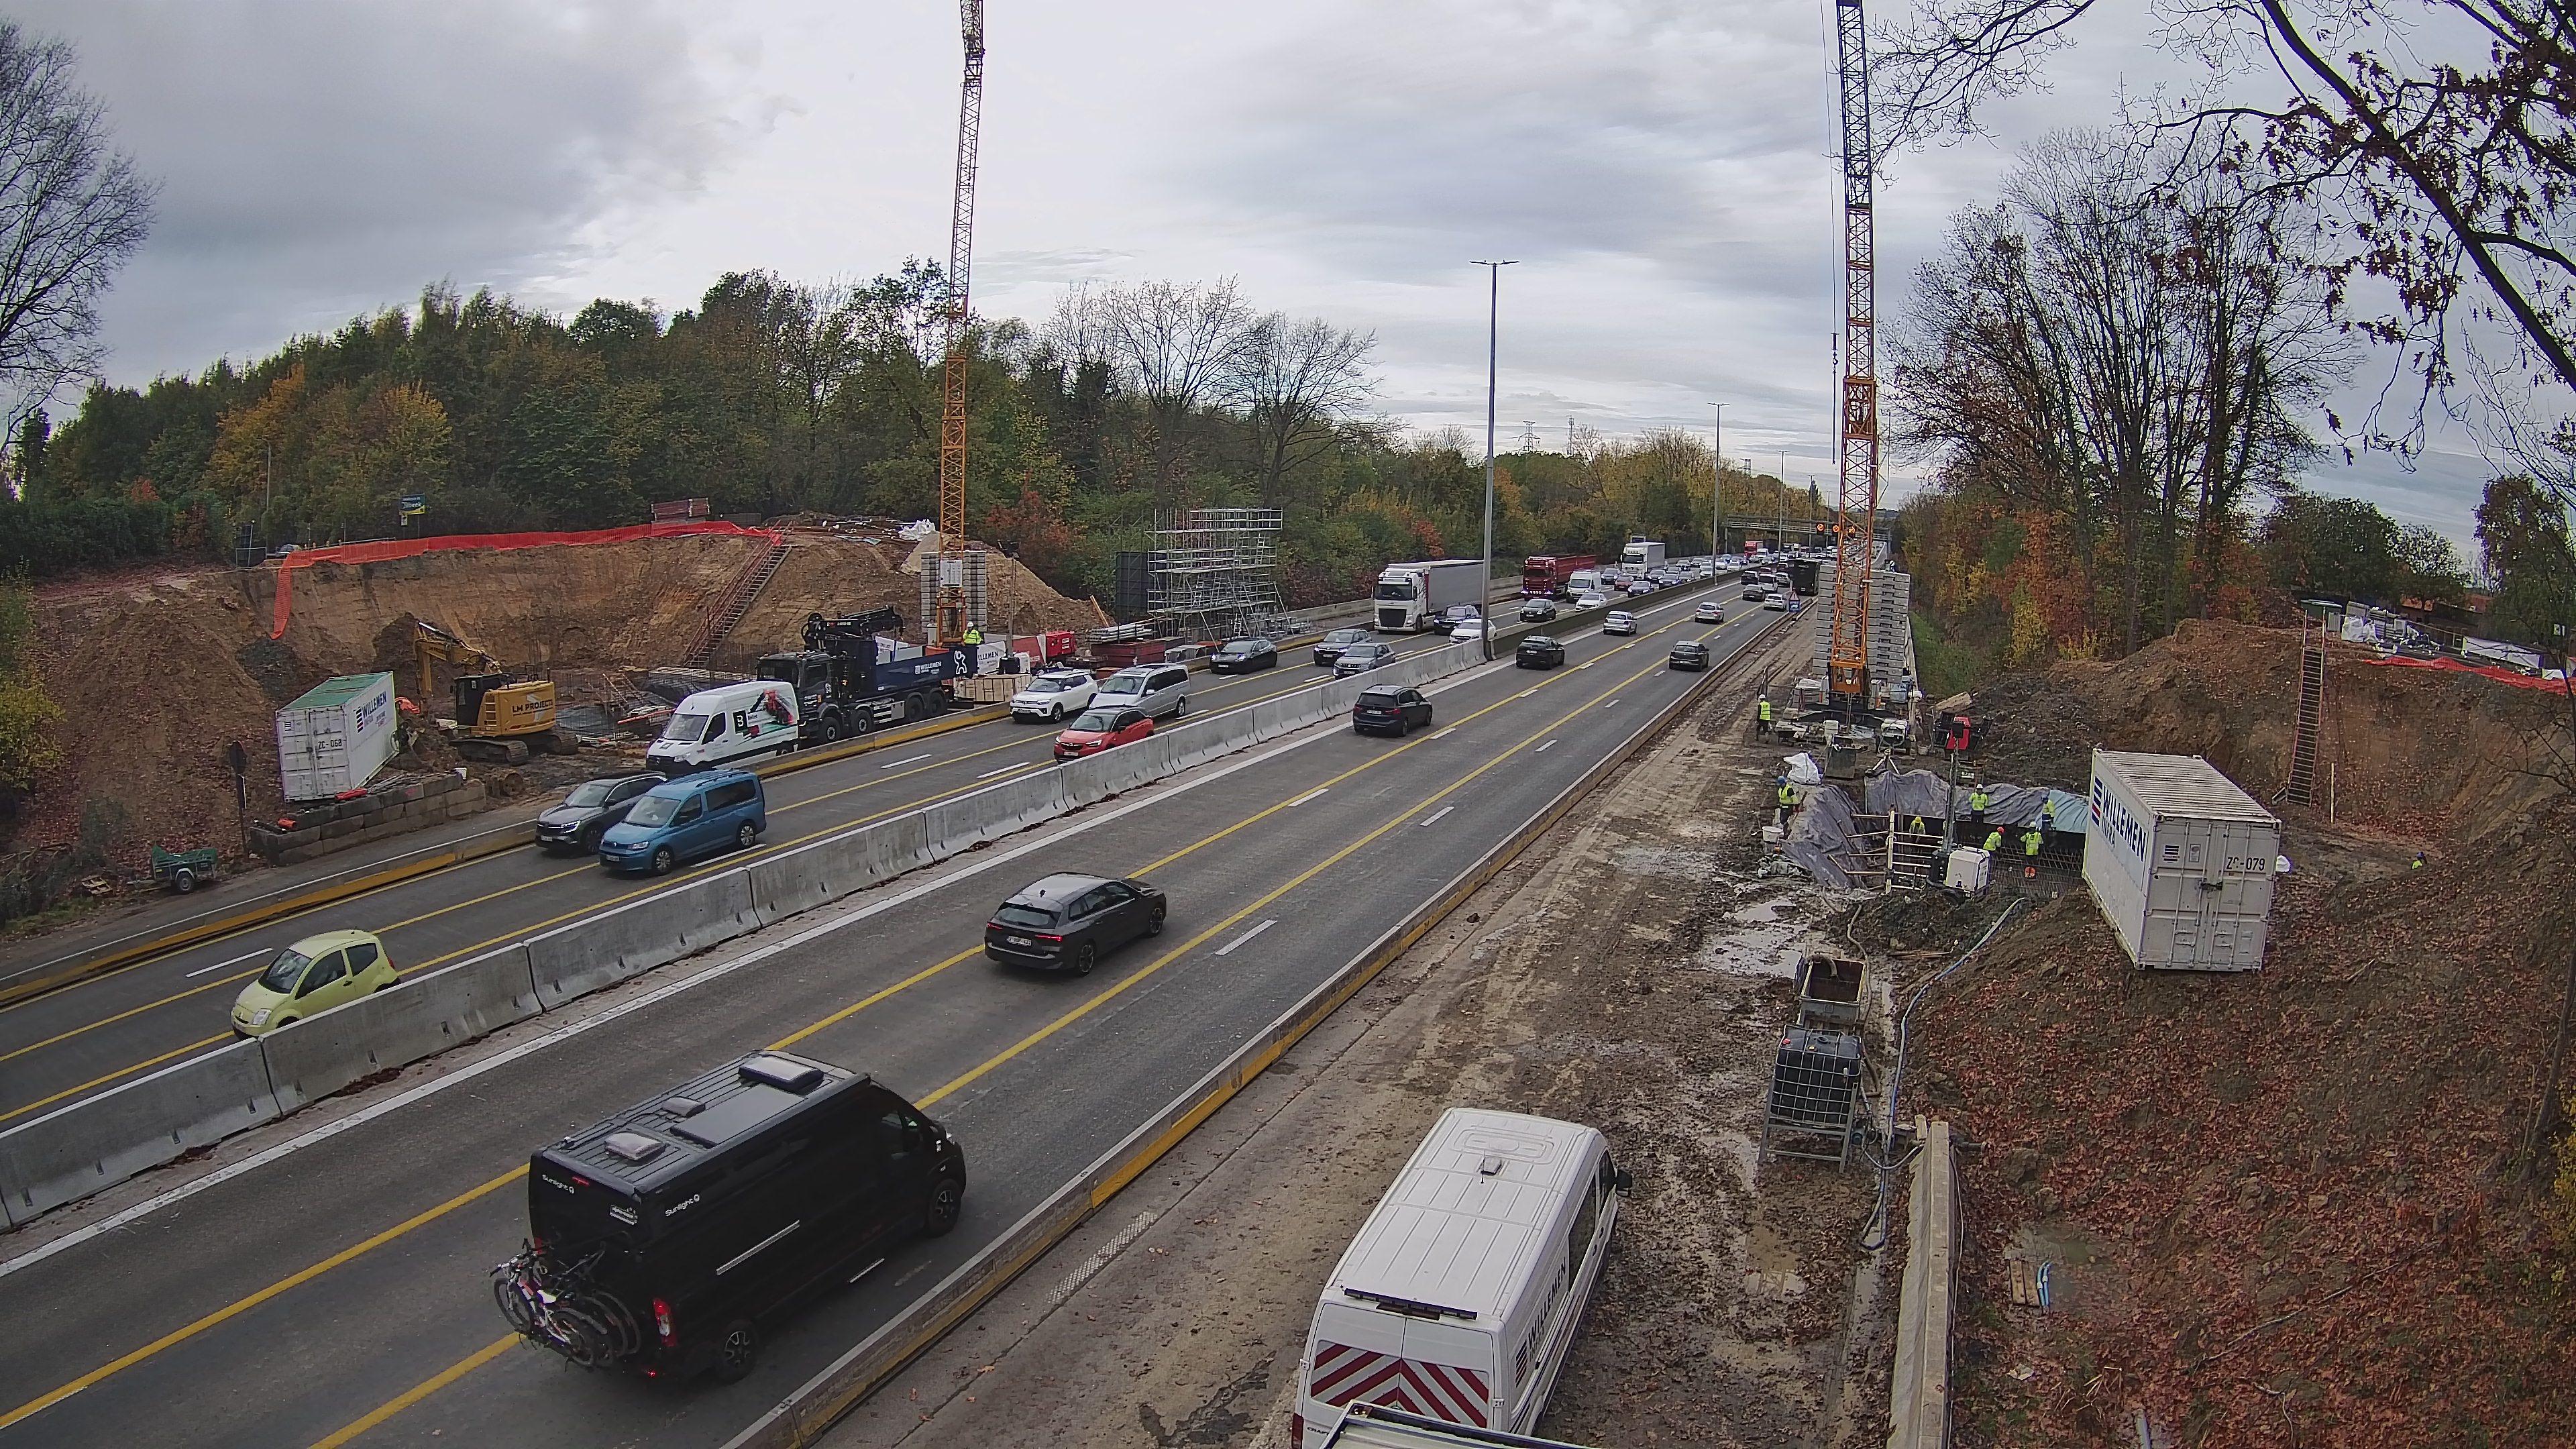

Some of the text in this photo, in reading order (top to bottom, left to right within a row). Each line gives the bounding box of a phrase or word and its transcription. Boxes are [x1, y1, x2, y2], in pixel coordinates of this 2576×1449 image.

[977, 651, 998, 660] ILLEMEN
[362, 690, 387, 718] WILLEMEN
[512, 699, 553, 712] LM PROJECTS
[2101, 816, 2116, 849] INFRA
[2102, 786, 2147, 862] WILLEMEN
[541, 1174, 569, 1191] Sunlight
[665, 1197, 694, 1217] Sunlight
[1527, 1256, 1566, 1350] WILLEMEN
